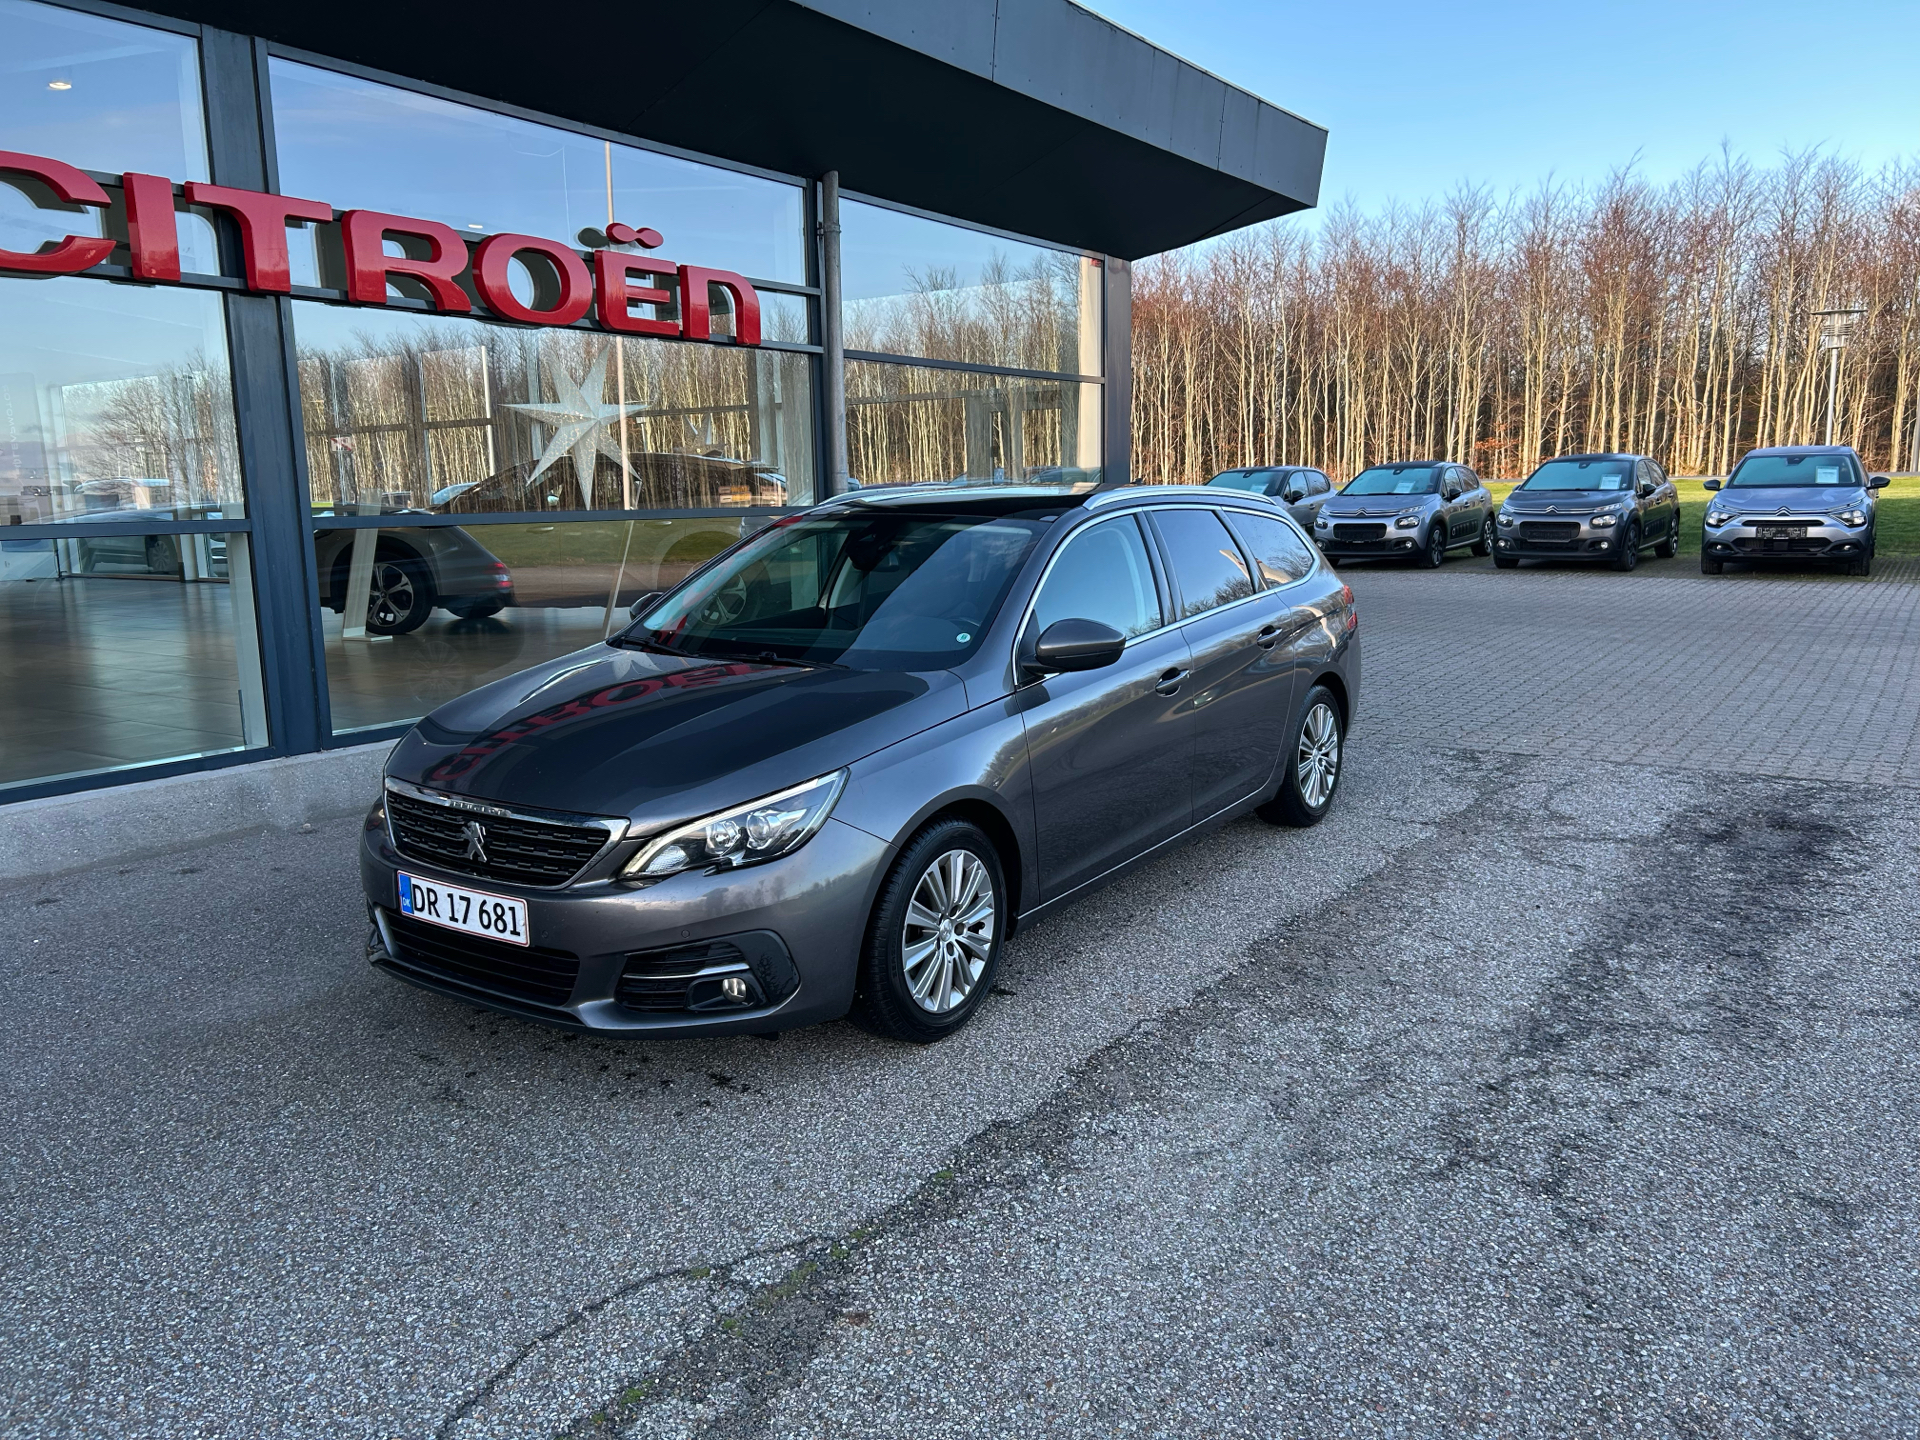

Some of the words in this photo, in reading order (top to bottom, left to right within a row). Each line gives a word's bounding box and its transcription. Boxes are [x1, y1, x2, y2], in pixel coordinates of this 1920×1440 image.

[402, 897, 411, 908] DK
[412, 884, 441, 919] DR
[447, 893, 472, 925] 17
[478, 900, 521, 937] 681
